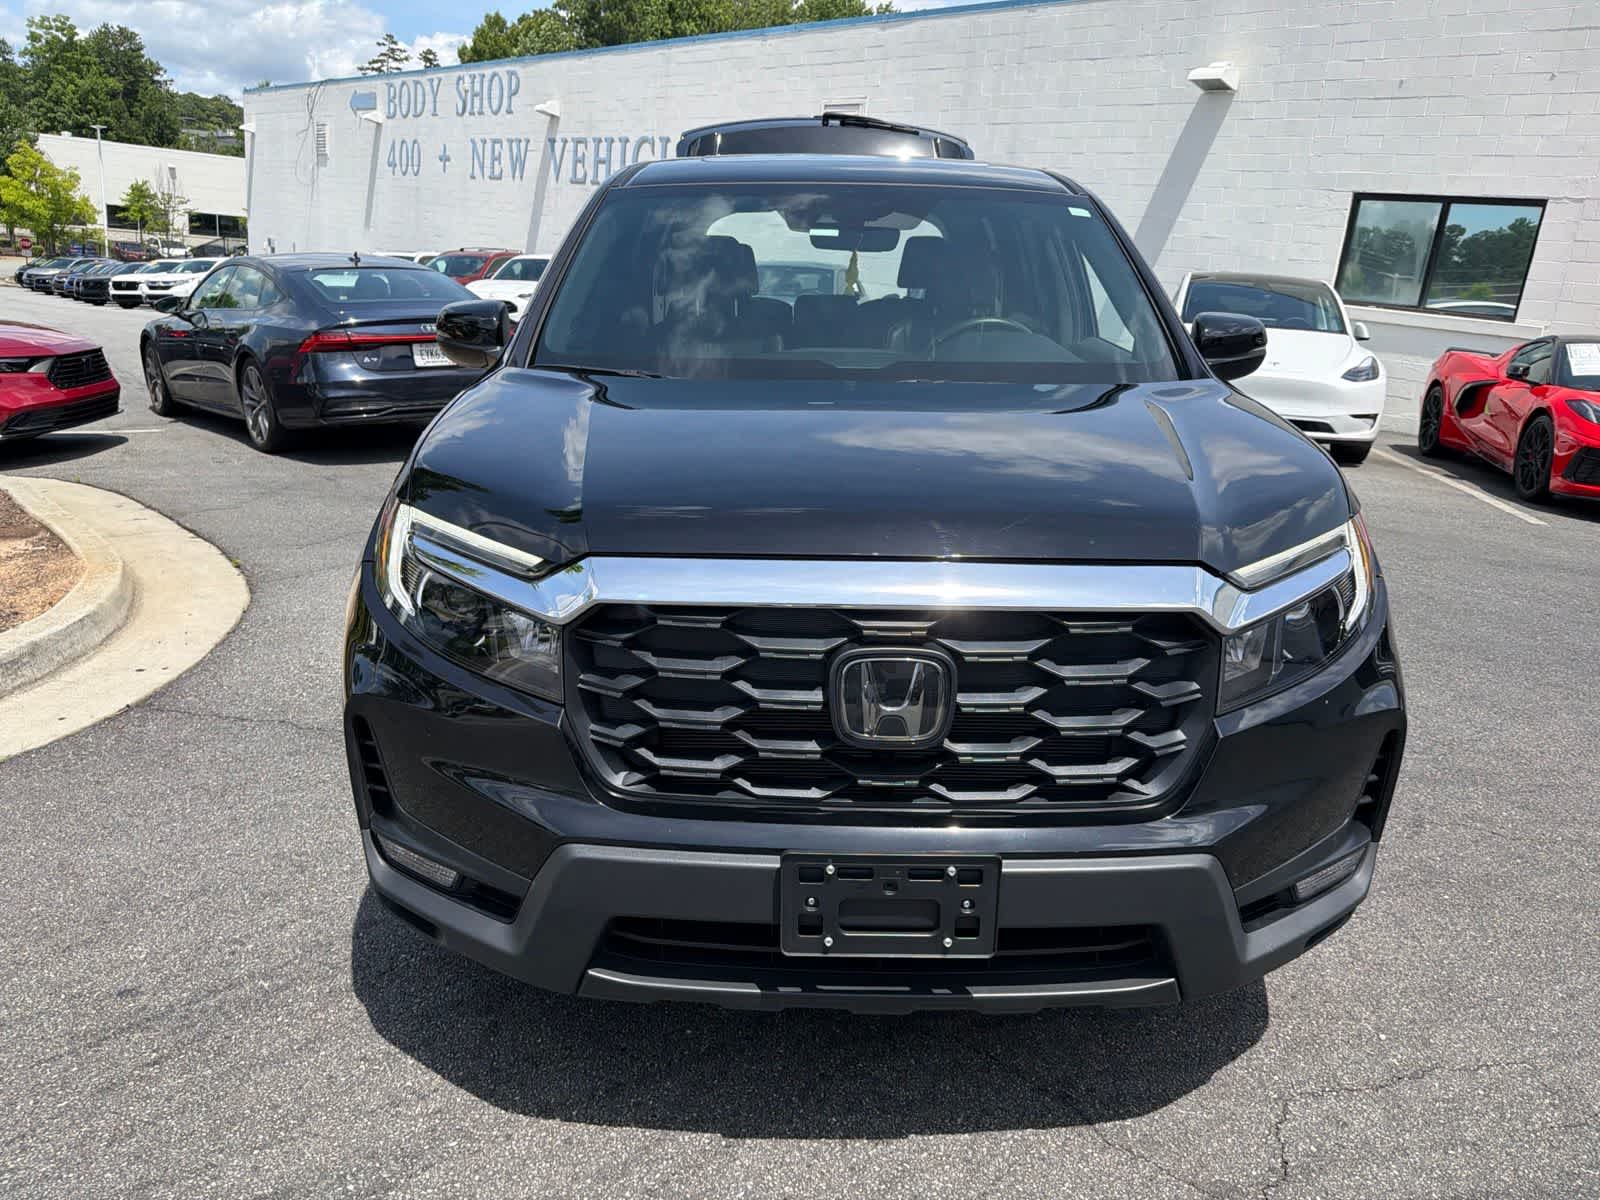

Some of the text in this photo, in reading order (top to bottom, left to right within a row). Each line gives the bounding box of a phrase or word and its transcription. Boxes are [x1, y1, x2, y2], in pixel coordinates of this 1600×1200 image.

[385, 69, 521, 119] BODY SHOP
[387, 138, 421, 176] 400
[438, 143, 451, 174] +
[469, 137, 531, 181] NEW
